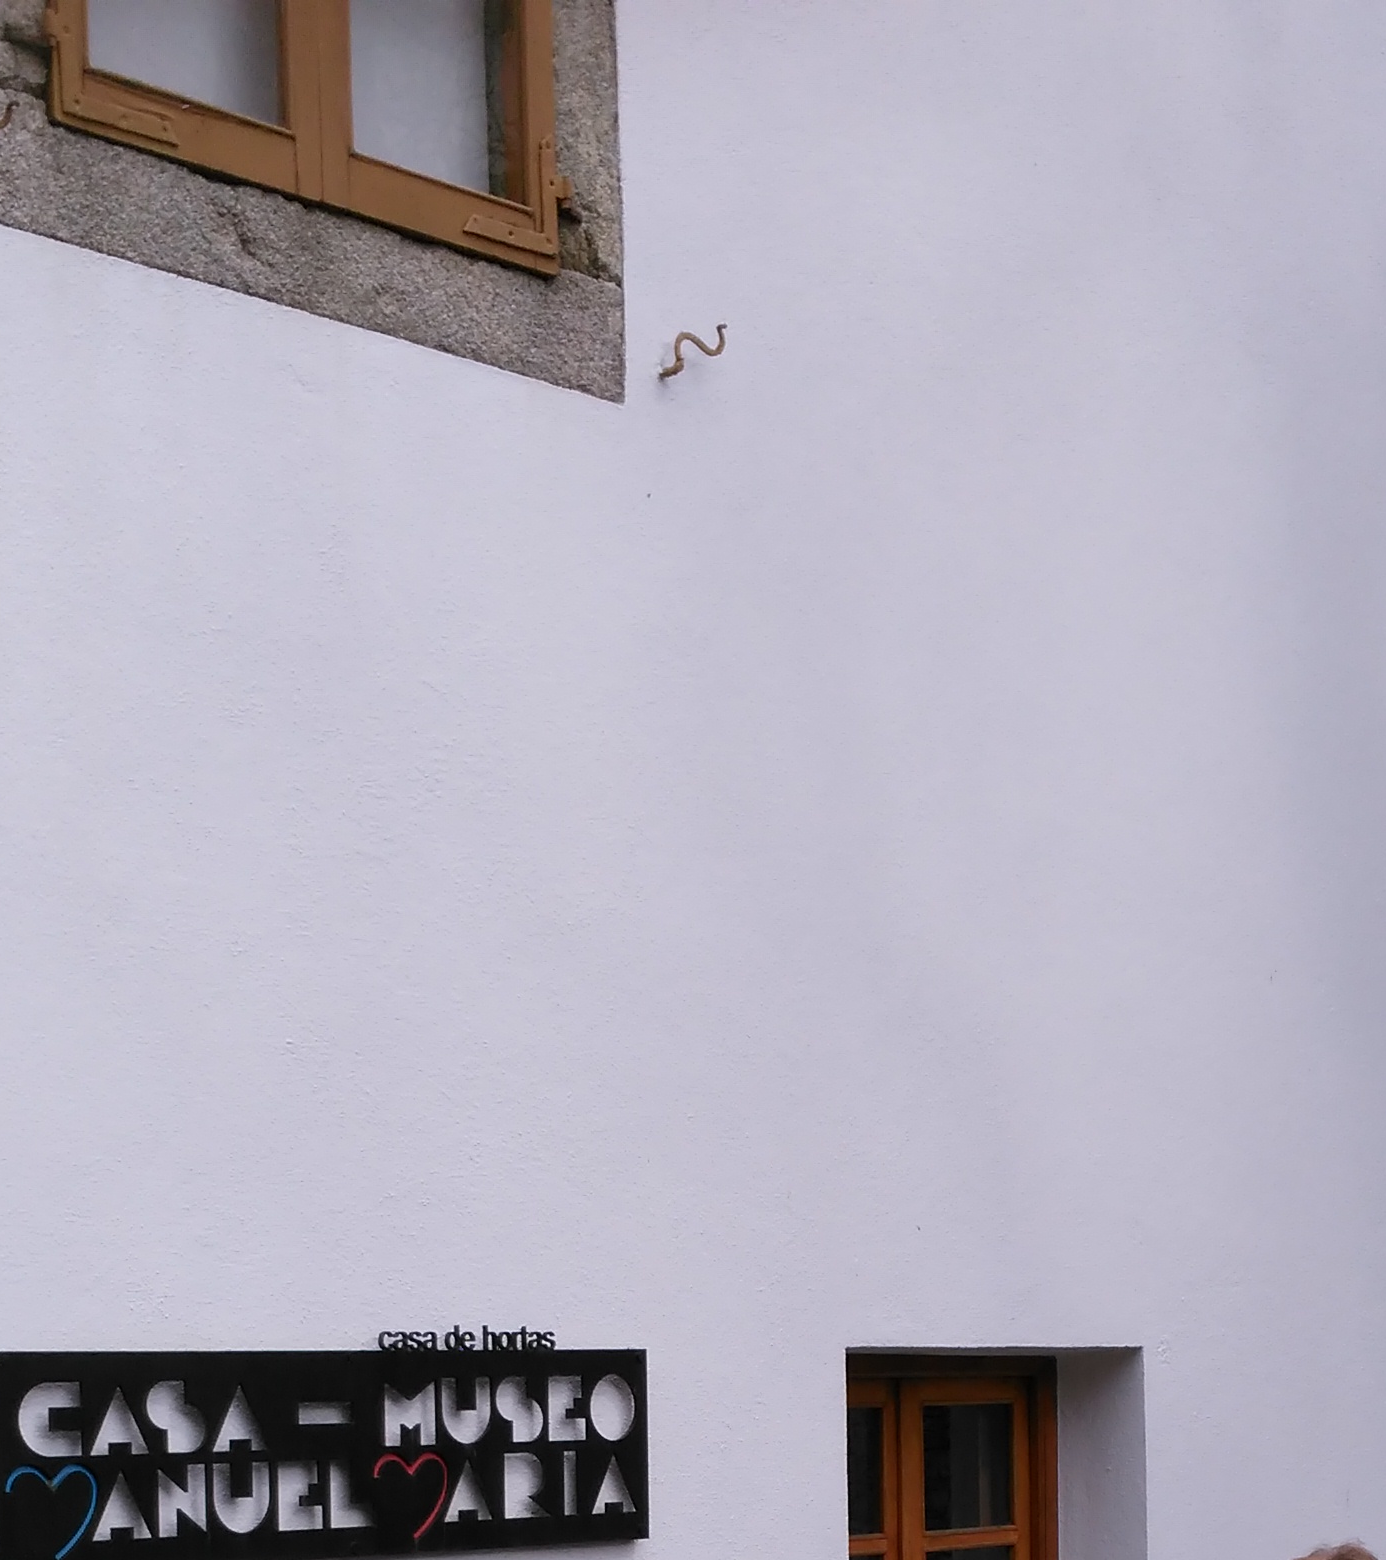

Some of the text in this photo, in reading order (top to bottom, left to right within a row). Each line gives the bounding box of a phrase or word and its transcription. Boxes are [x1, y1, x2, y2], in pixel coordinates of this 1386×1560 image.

[378, 1325, 557, 1350] casa de hortas
[18, 1381, 268, 1456] CASA
[384, 1373, 636, 1447] MUSEO
